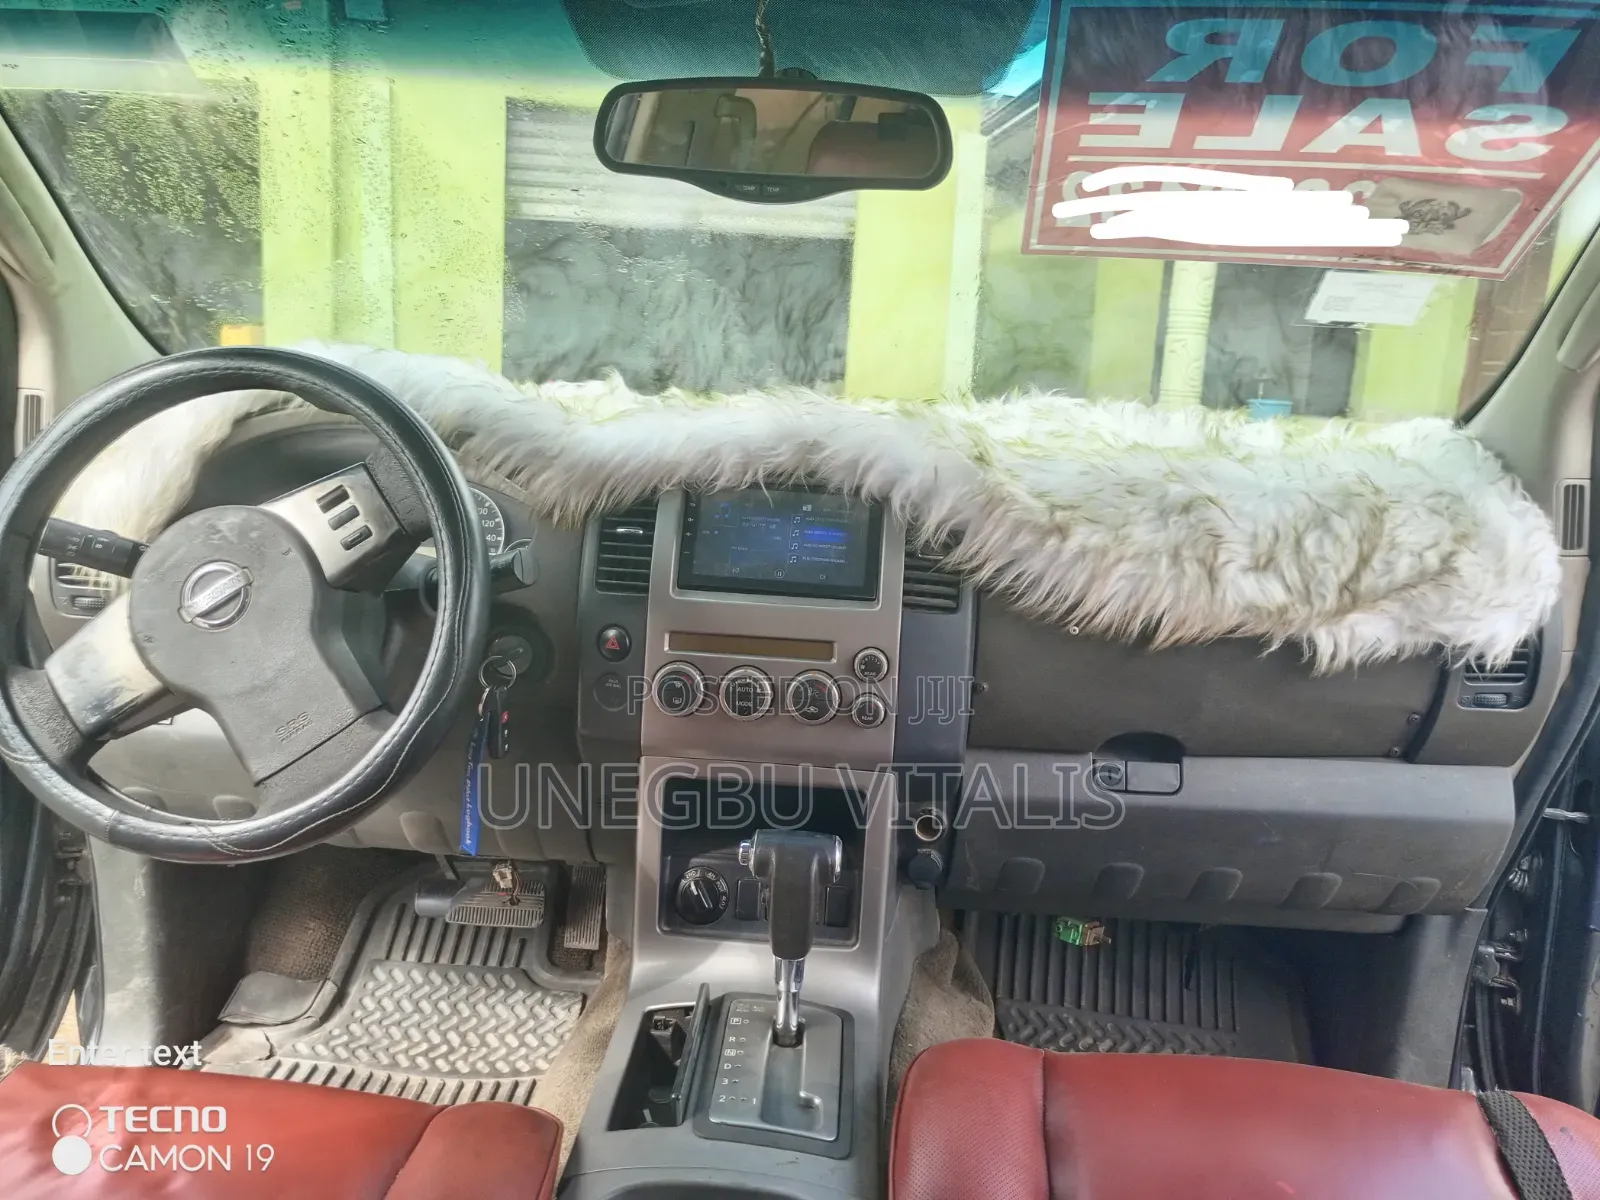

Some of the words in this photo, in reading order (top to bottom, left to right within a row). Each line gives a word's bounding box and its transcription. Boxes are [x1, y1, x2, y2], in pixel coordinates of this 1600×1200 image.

[482, 519, 495, 528] 120
[736, 700, 753, 708] MODE
[719, 1094, 726, 1102] 2
